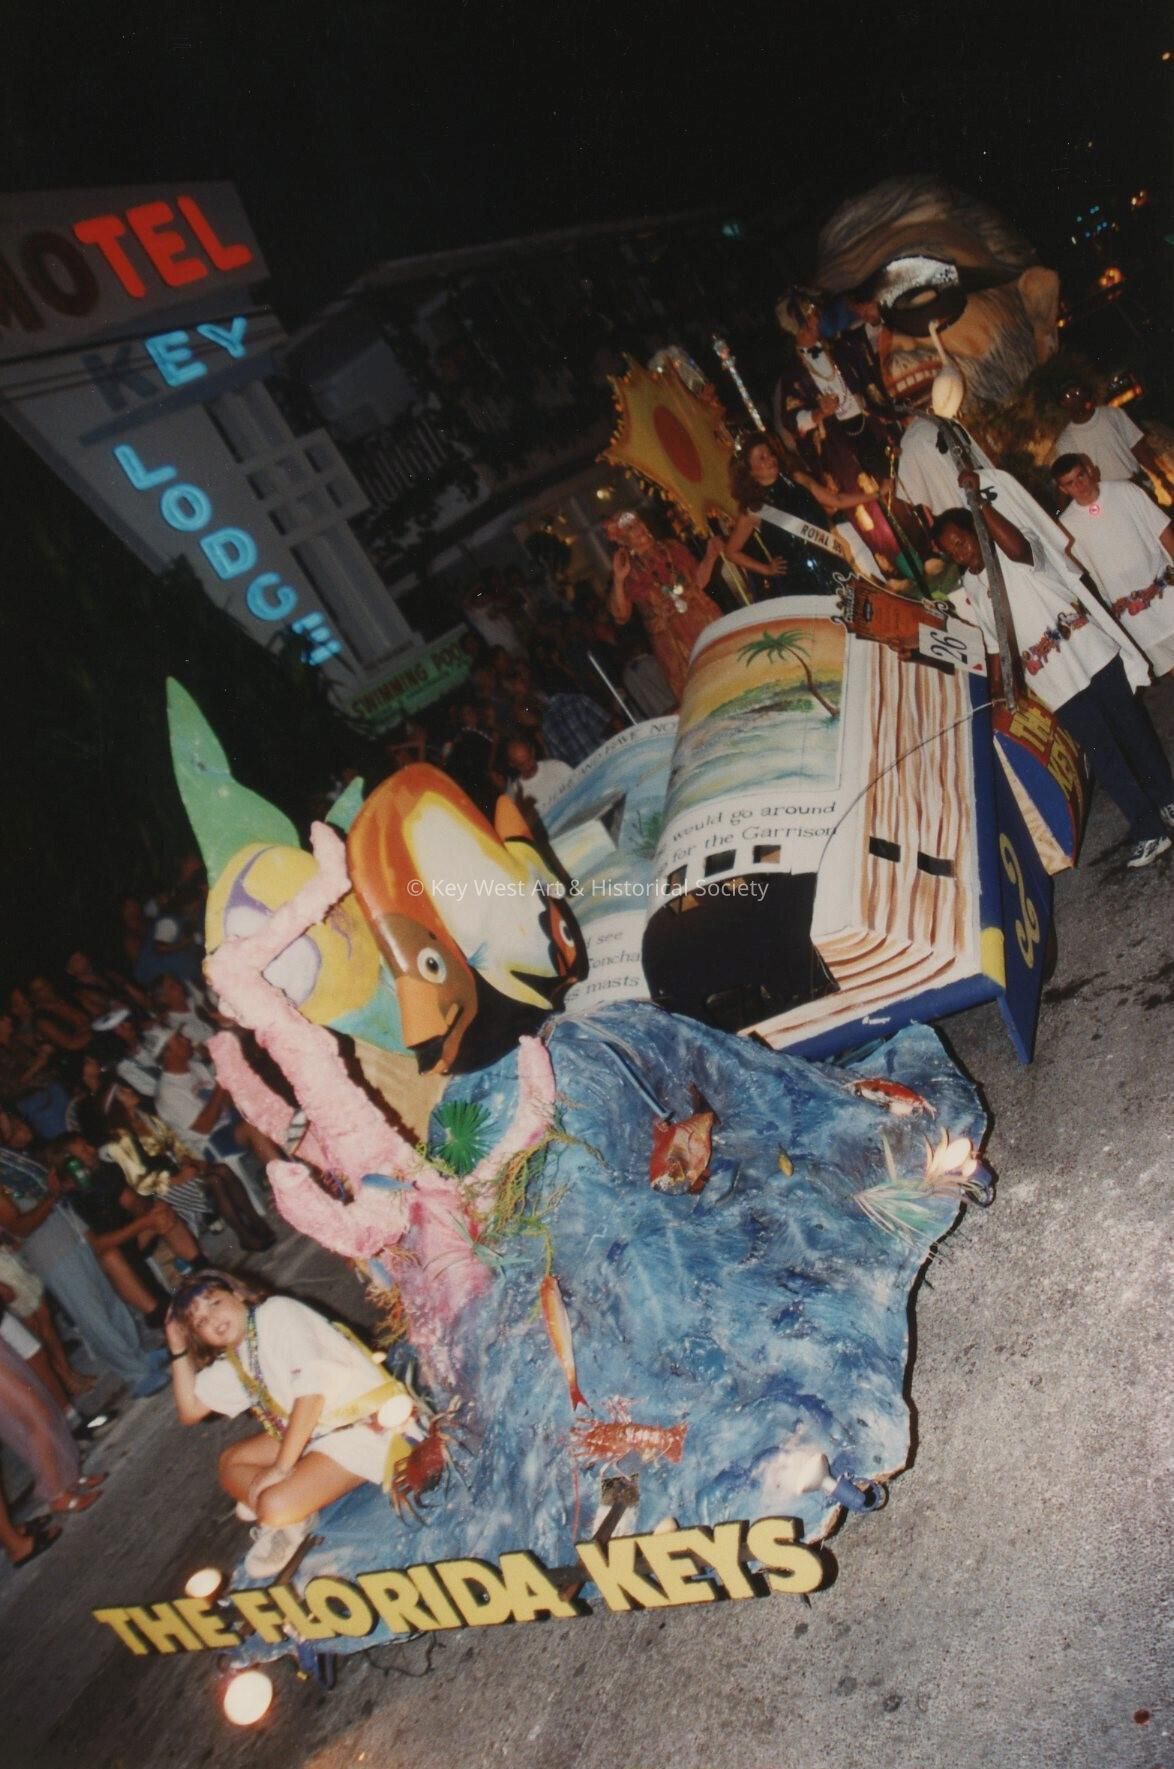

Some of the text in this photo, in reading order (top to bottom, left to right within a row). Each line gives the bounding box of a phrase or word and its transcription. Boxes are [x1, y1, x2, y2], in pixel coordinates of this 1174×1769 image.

[0, 195, 252, 337] MOTEL
[83, 317, 248, 410] KEY
[114, 443, 344, 667] LODGE
[800, 524, 829, 546] ROYAL
[929, 630, 968, 665] 26
[351, 663, 428, 717] SWIMMING
[1009, 707, 1053, 753] THE
[671, 844, 697, 864] for
[703, 832, 736, 850] the
[741, 824, 838, 841] Garrison
[672, 801, 837, 843] would go around
[596, 930, 624, 945] see
[586, 975, 641, 995] masts
[92, 1516, 836, 1656] THE FLORIDA KEYS
